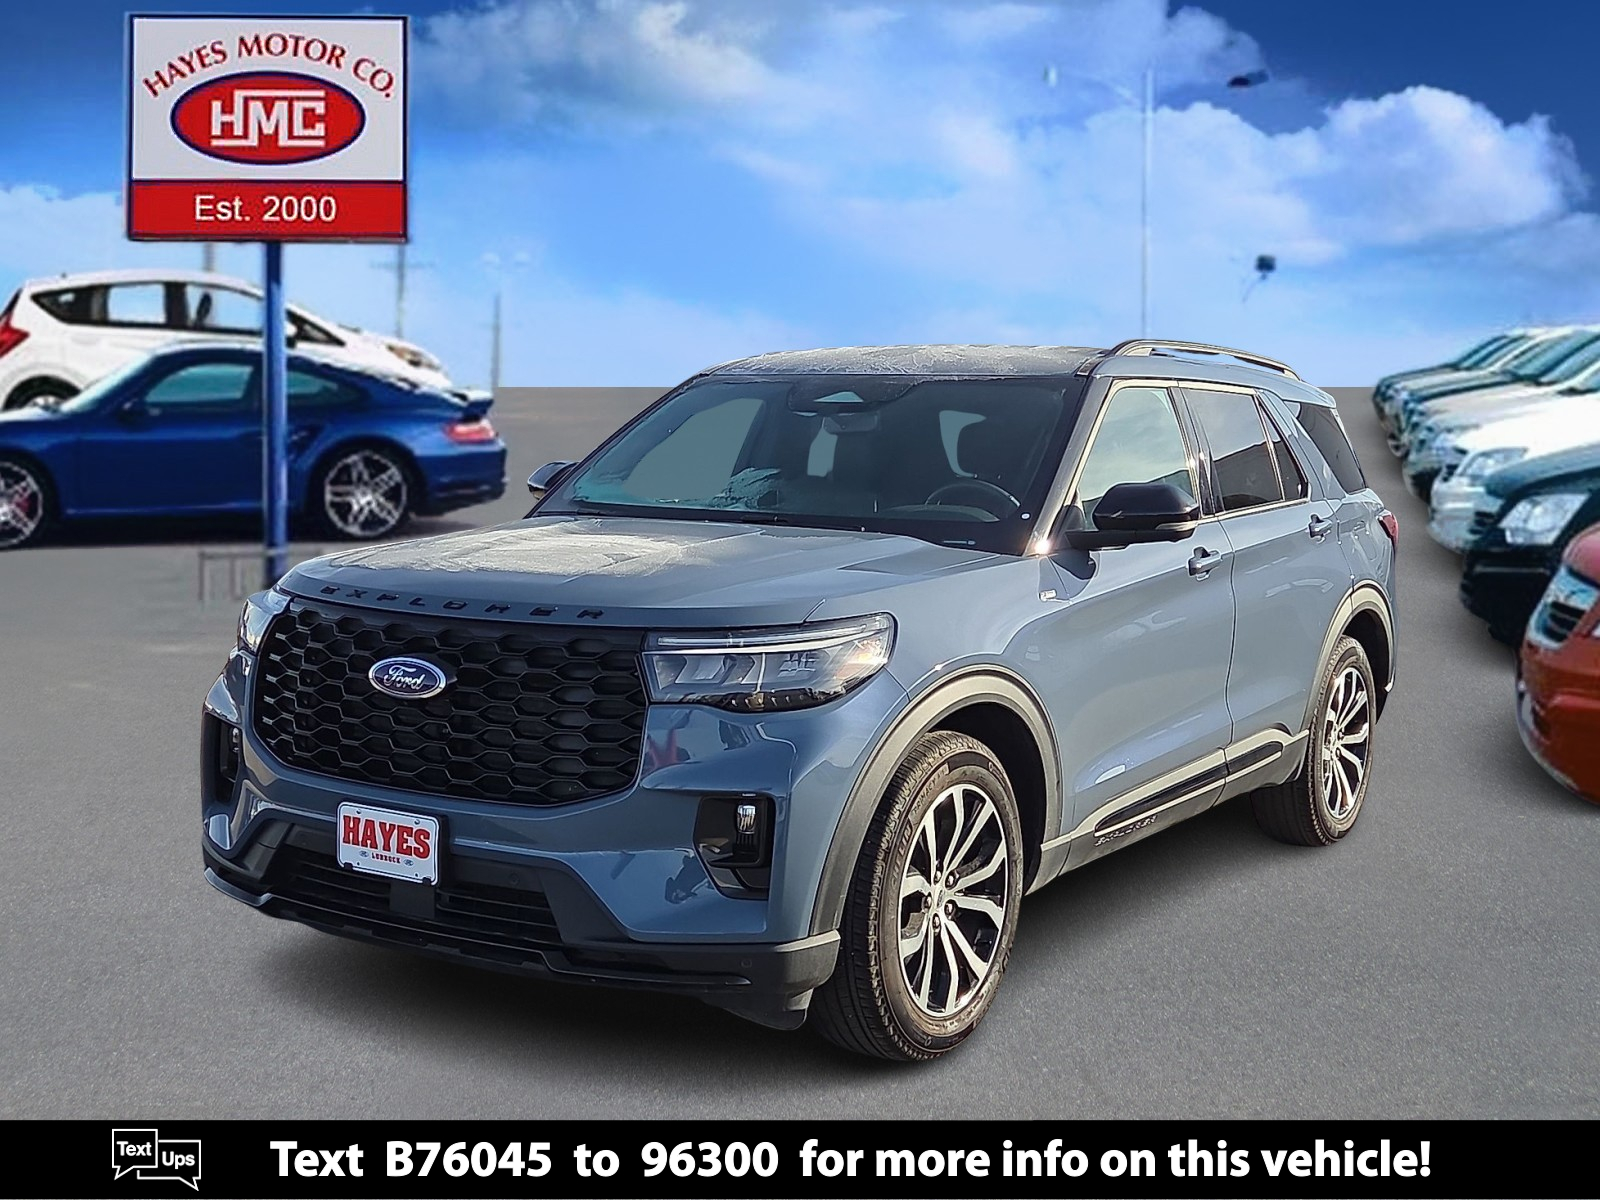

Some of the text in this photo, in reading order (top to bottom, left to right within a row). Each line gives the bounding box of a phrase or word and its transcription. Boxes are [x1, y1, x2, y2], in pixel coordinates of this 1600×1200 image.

[142, 33, 395, 98] HAYES MOTOR CO.
[211, 89, 326, 147] HMC
[194, 194, 337, 222] Est. 2000
[320, 585, 605, 620] EXPLORER
[383, 664, 426, 690] Ford
[342, 815, 431, 859] HAYES
